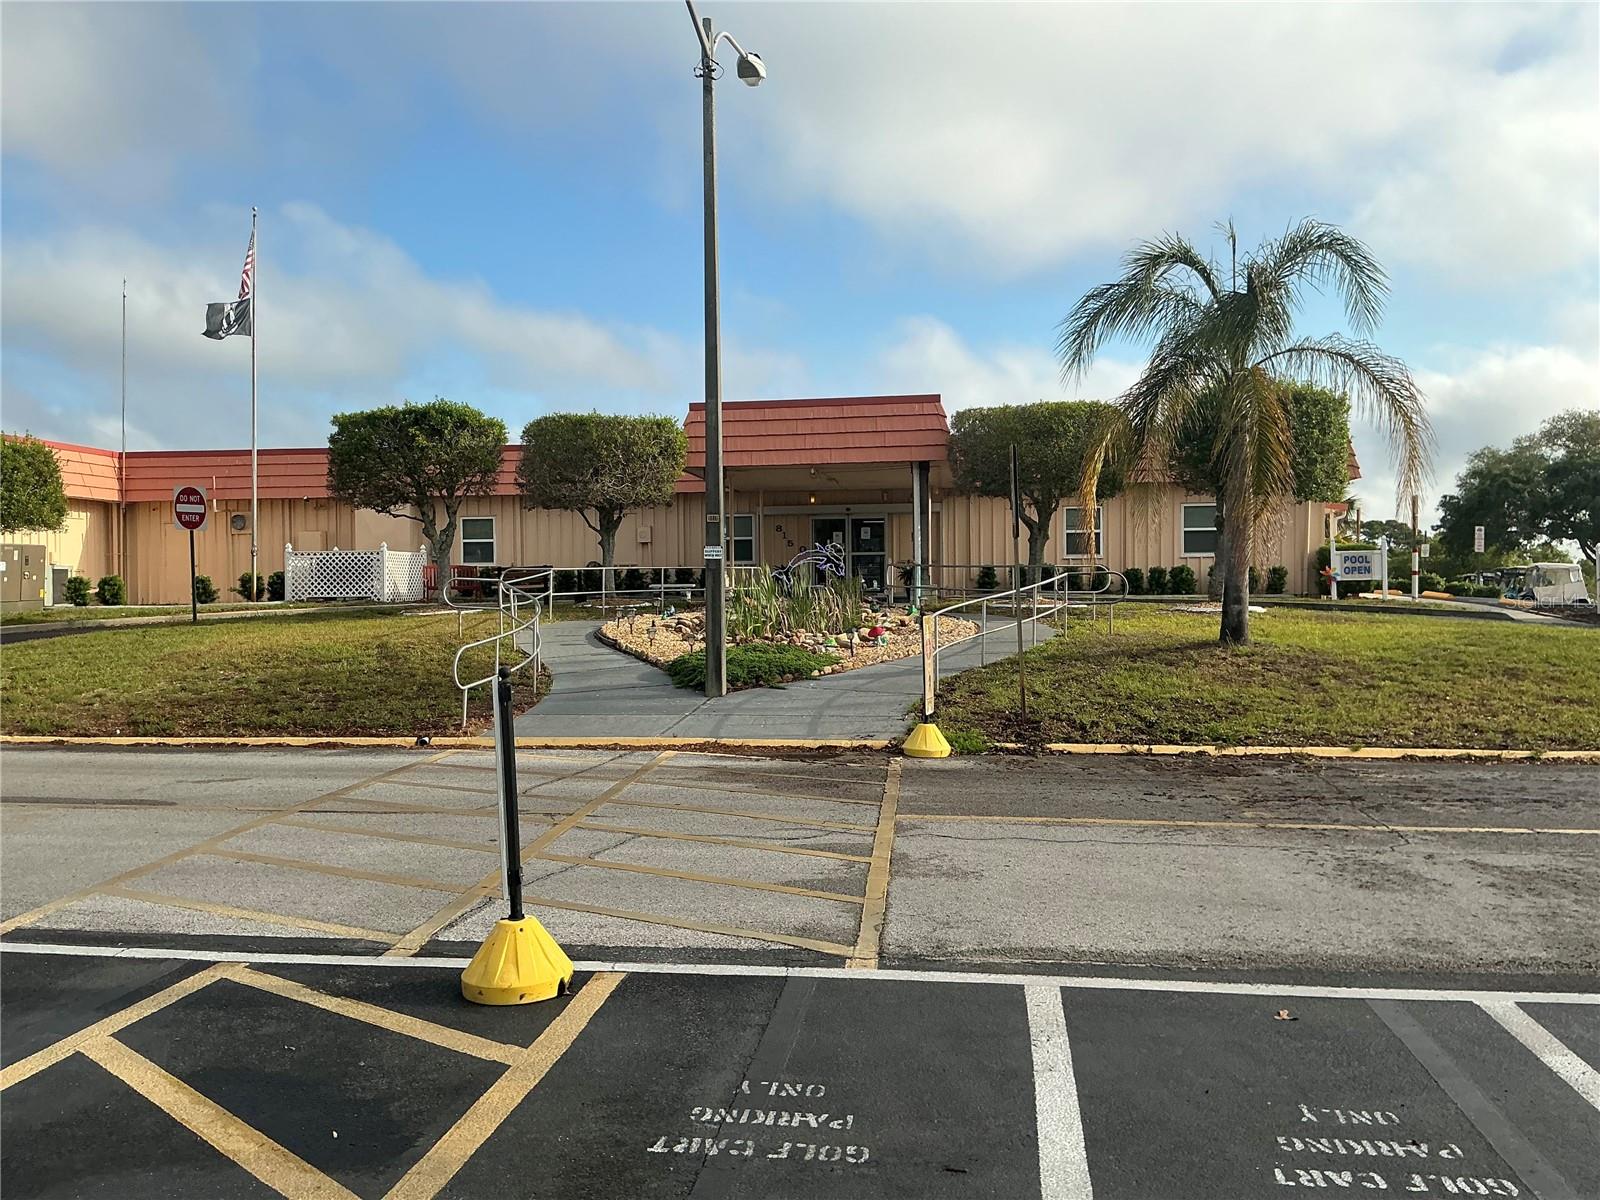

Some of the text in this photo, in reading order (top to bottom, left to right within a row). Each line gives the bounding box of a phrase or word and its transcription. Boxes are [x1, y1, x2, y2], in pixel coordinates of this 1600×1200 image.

[1344, 556, 1371, 564] POOL
[1344, 566, 1371, 574] OPEN
[733, 1080, 825, 1097] ONLY
[690, 1106, 853, 1129] PARKING
[1298, 1104, 1399, 1125] ONLY
[647, 1136, 869, 1163] GOLF CART
[1276, 1136, 1464, 1158] PARKING
[1274, 1168, 1519, 1197] GOLF CART
